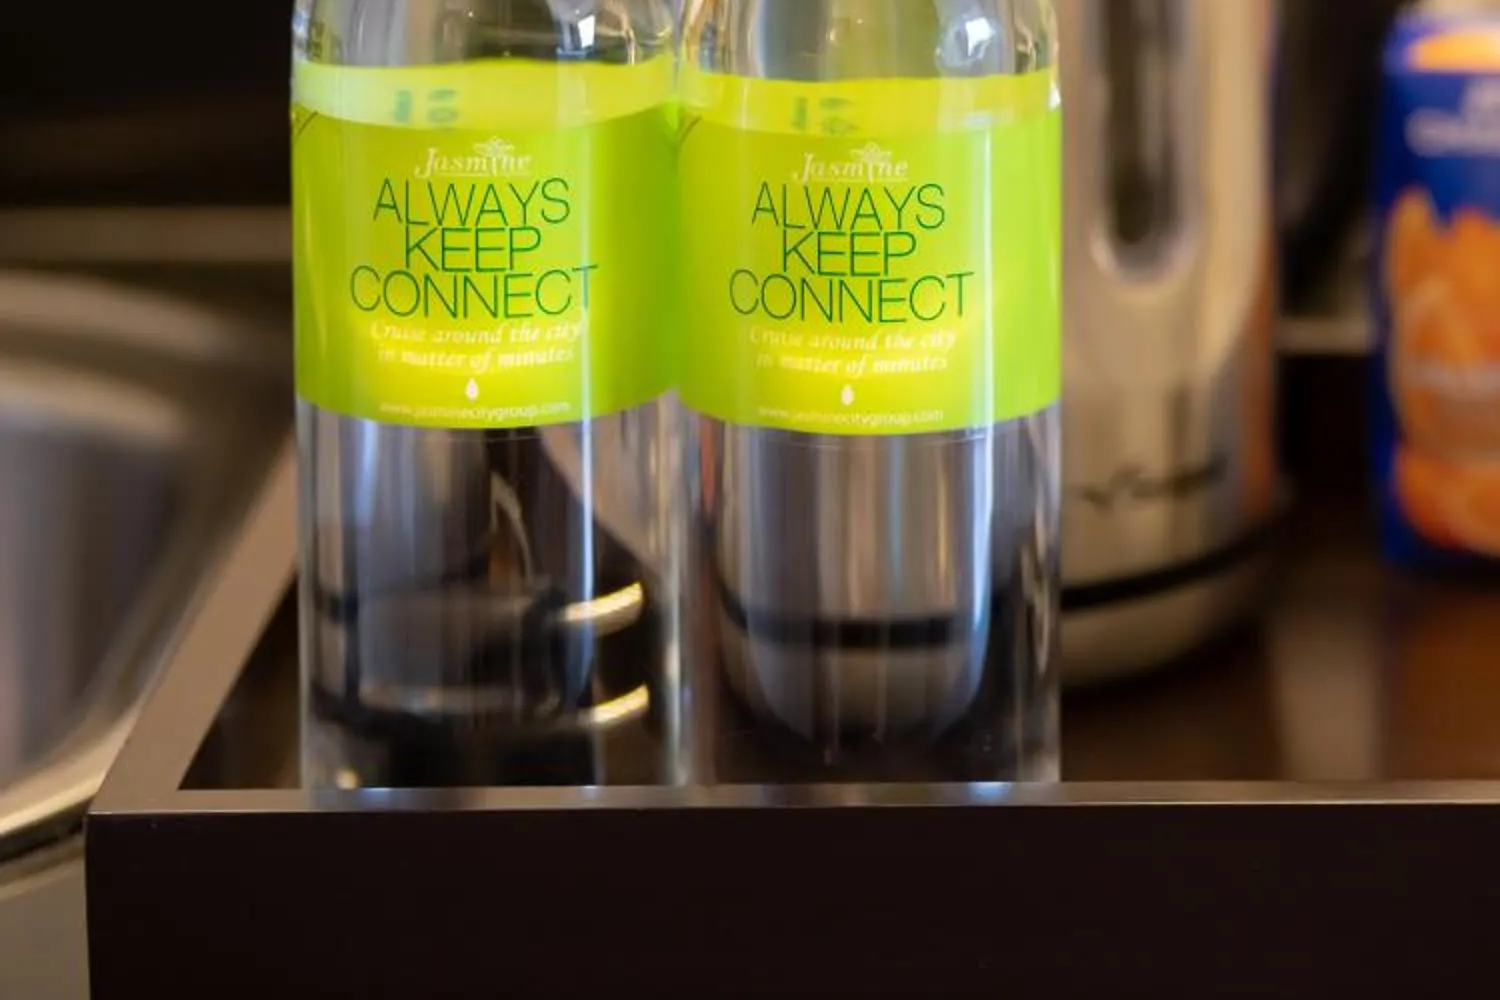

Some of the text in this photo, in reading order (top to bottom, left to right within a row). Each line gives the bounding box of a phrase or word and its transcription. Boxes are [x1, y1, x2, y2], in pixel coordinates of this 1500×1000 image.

[413, 137, 532, 178] Jasmine
[792, 140, 909, 184] Jasmine
[373, 177, 571, 227] ALWAYS
[752, 181, 945, 230] ALWAYS
[404, 225, 542, 273] KEEP
[782, 229, 917, 278] KEEP
[351, 265, 598, 320] CONNECT
[729, 269, 974, 324] CONNECT
[432, 322, 503, 344] around
[509, 322, 540, 343] the
[545, 321, 584, 345] city
[809, 329, 881, 350] around
[884, 329, 913, 349] the
[919, 328, 959, 353] city
[378, 343, 575, 375] in matter of minutes
[756, 354, 949, 380] in matter of minutes
